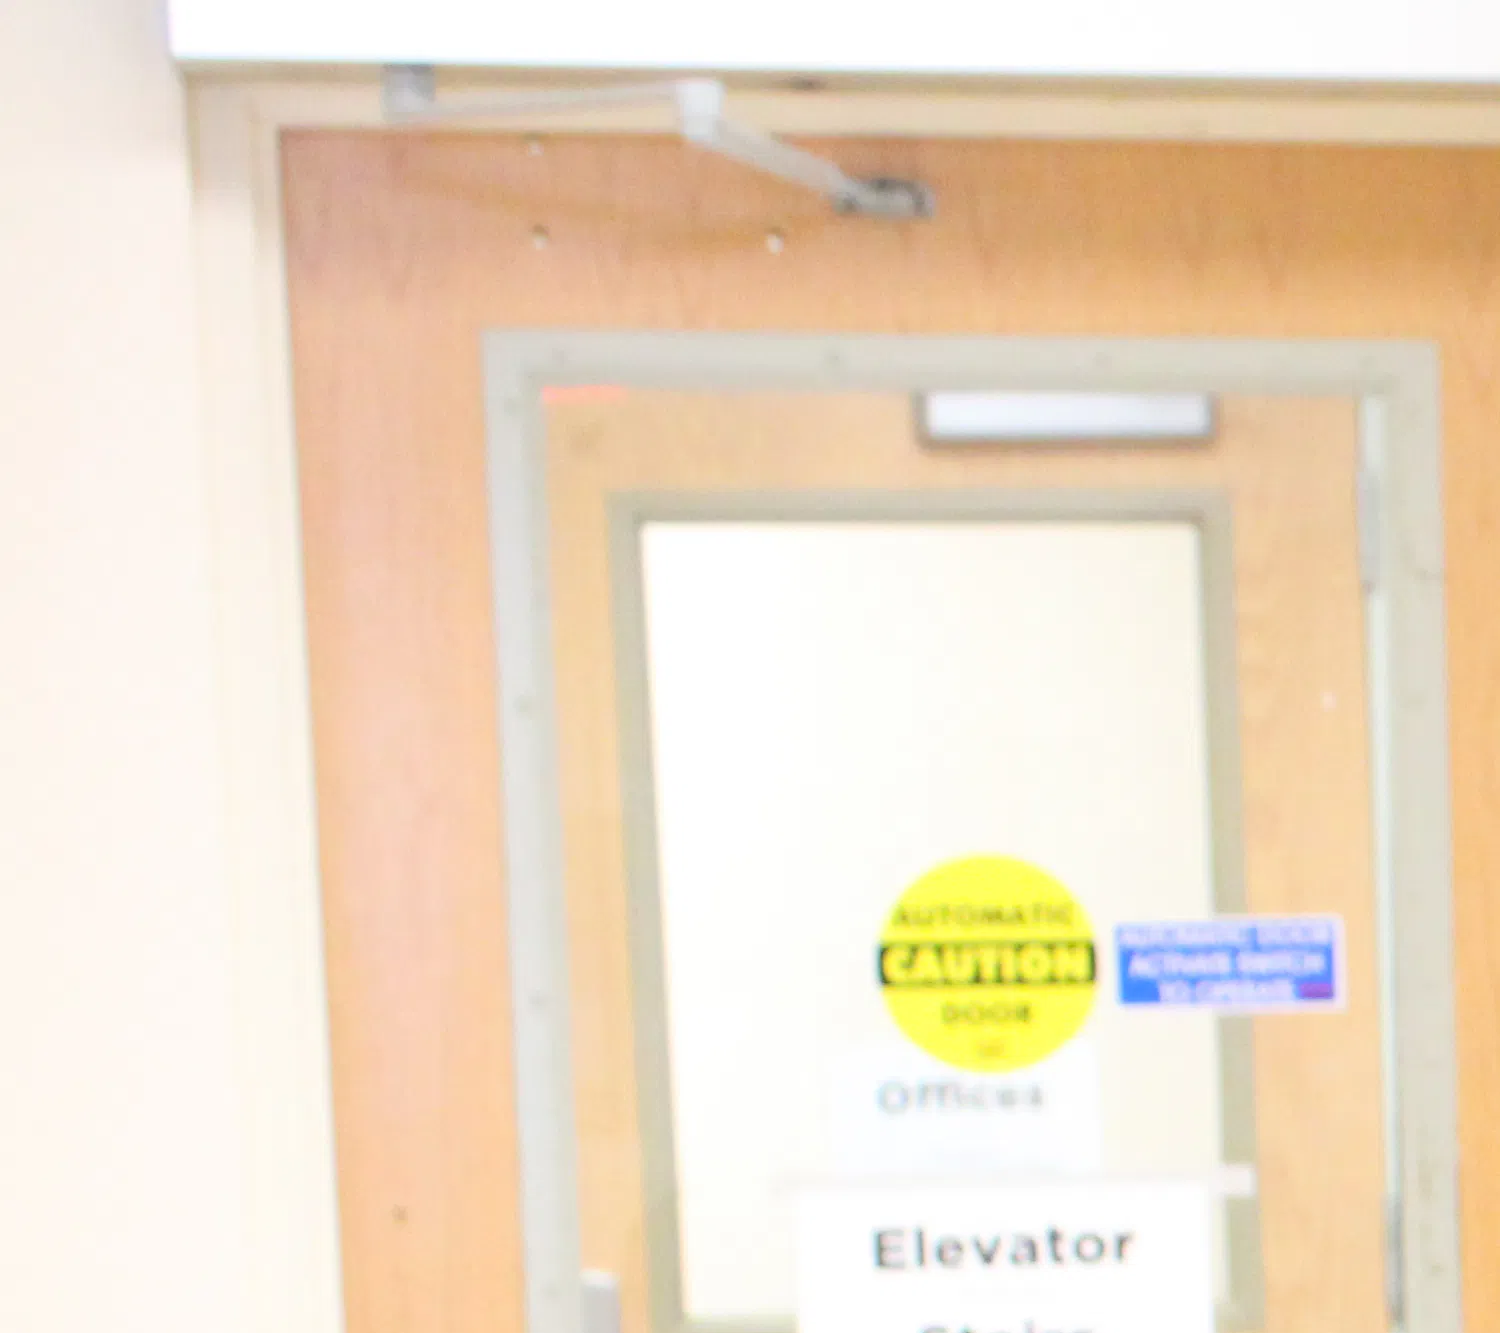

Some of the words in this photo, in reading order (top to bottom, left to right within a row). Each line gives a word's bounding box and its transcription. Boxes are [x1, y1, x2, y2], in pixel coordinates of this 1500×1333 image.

[893, 903, 1073, 928] AUTOMATIC
[882, 943, 1094, 985] CAUTION
[941, 1001, 1032, 1026] DOOR
[872, 1225, 1134, 1270] Elevator
